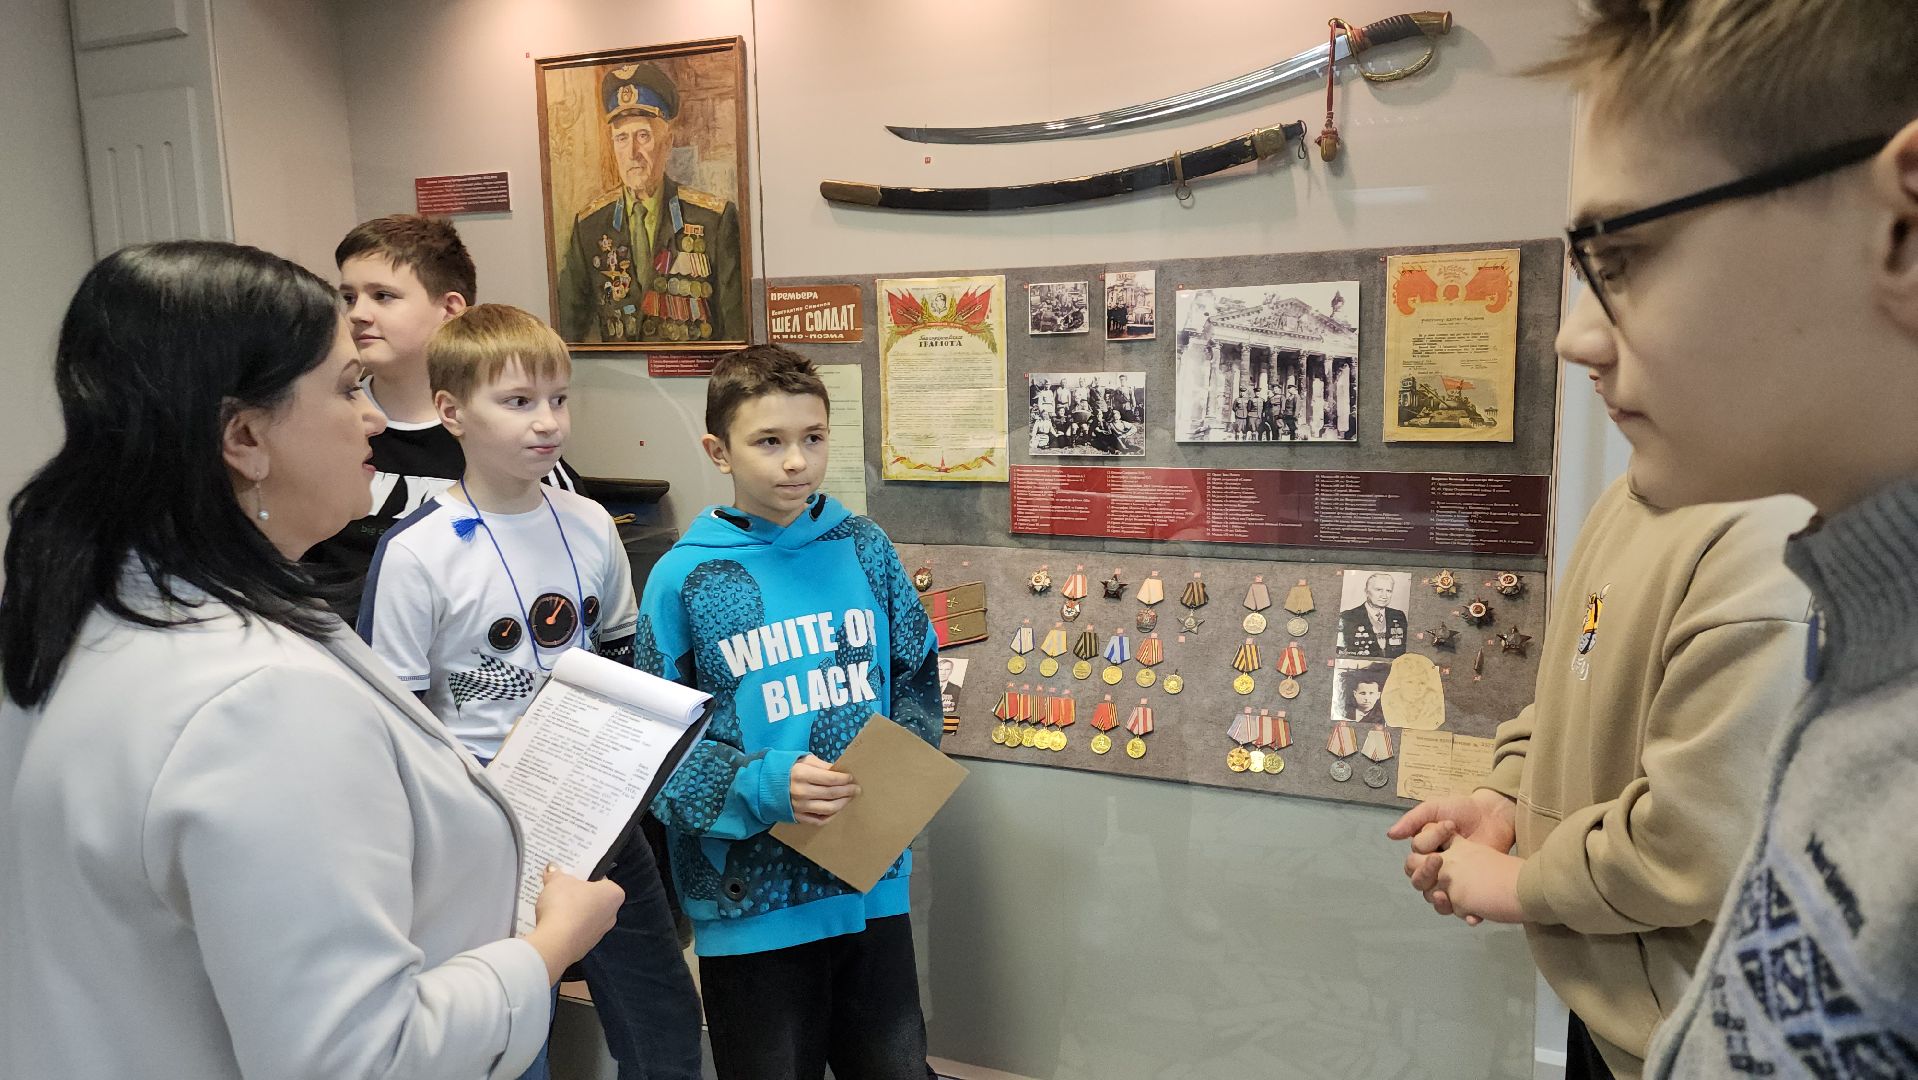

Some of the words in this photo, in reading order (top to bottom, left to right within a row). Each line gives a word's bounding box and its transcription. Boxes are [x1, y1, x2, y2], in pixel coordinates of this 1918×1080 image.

[770, 291, 818, 301] ПРЕМЬЕРА
[771, 314, 801, 333] ШЕЛ
[718, 611, 838, 678] WHITE
[762, 661, 876, 723] BLACK
